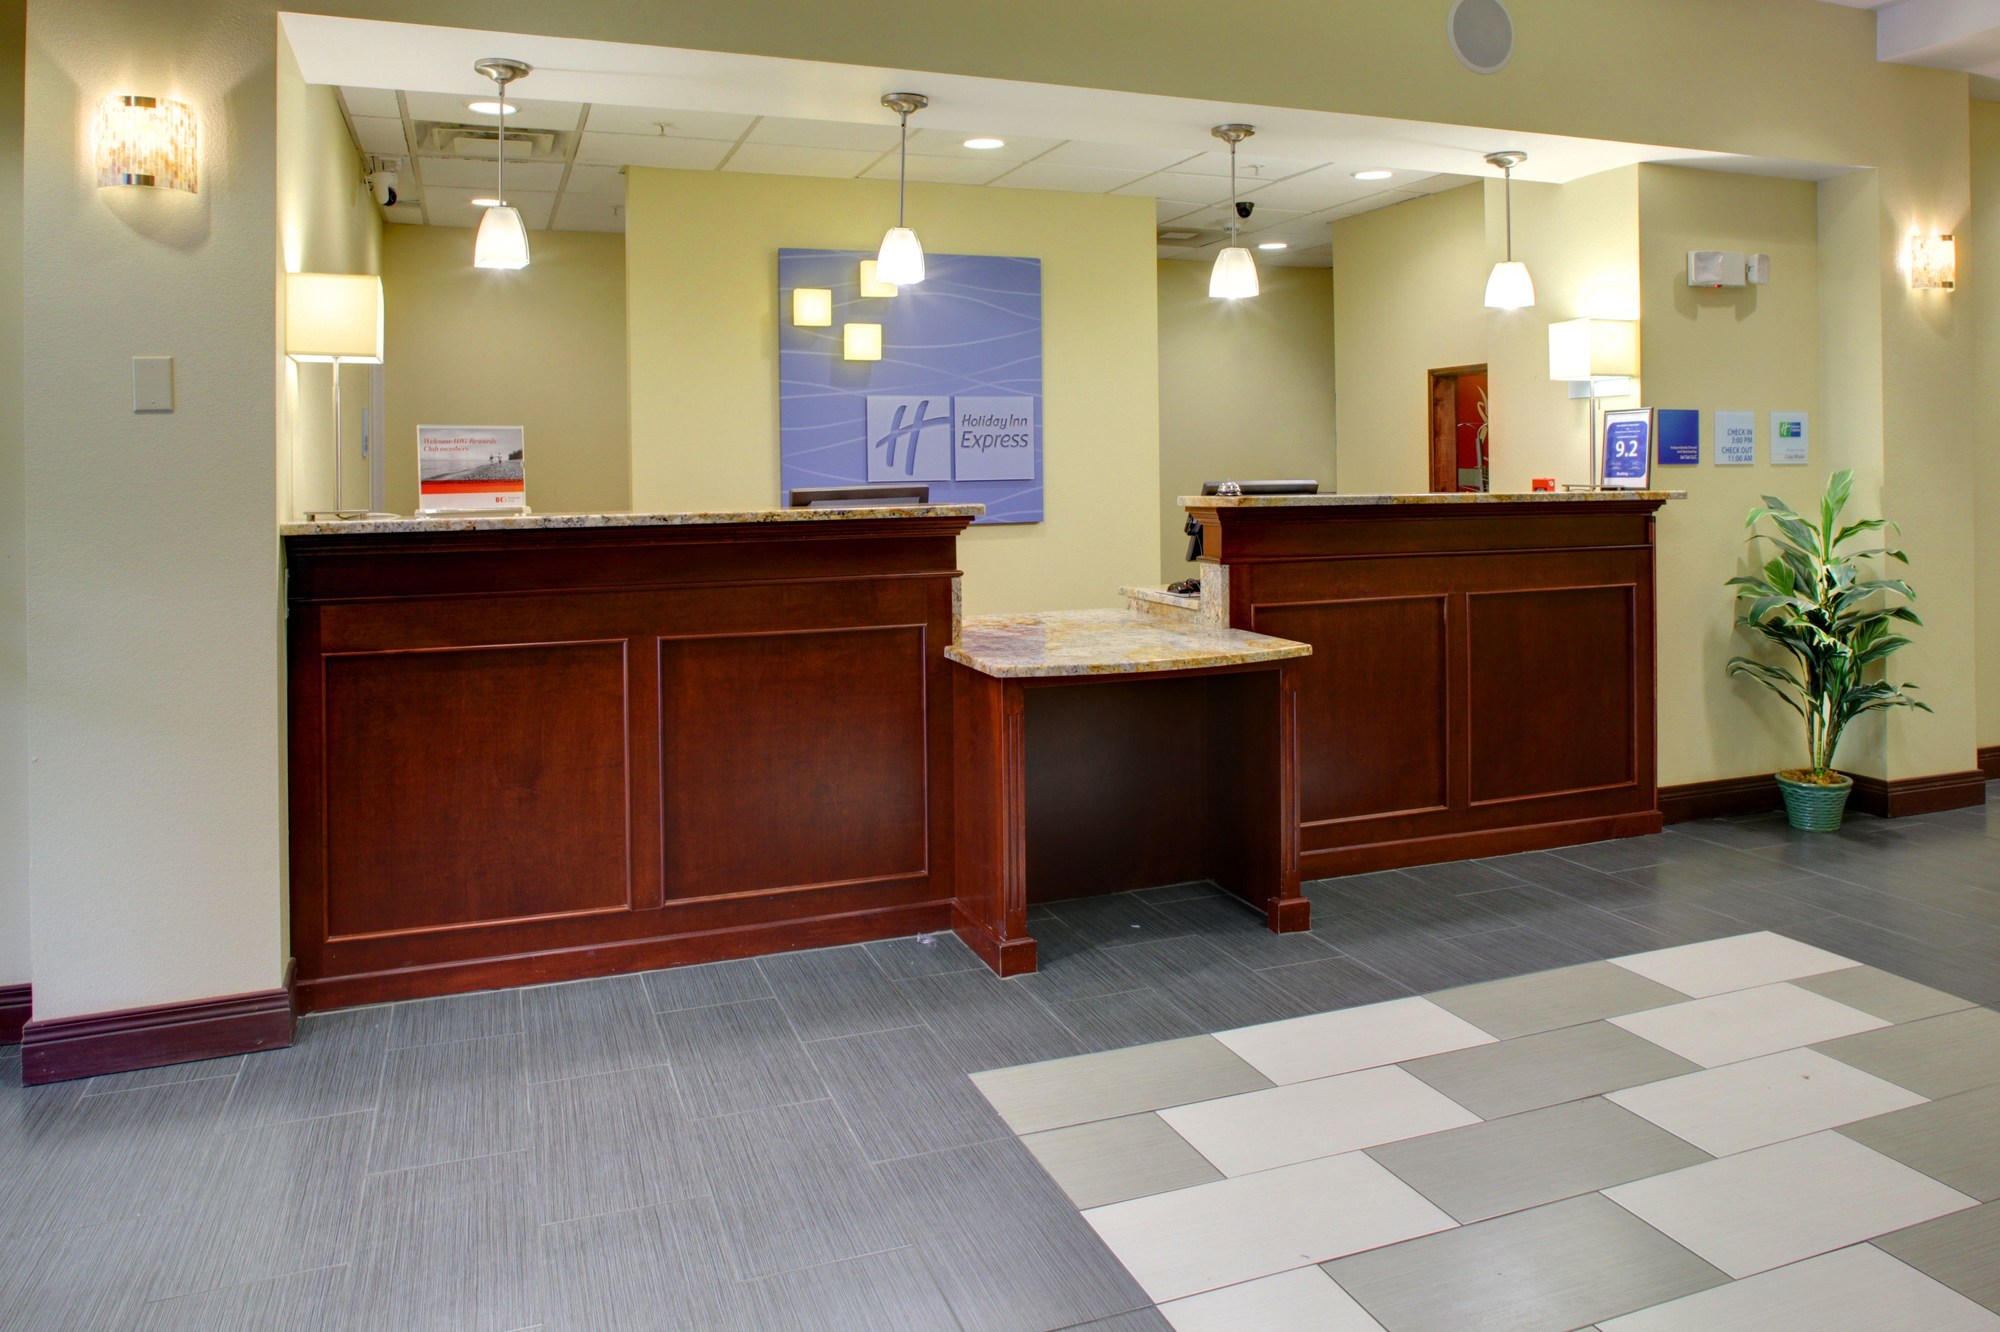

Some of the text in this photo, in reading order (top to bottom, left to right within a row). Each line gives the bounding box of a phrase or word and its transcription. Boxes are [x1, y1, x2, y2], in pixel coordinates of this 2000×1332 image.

[961, 414, 1028, 429] Holiday Inn
[1727, 428, 1753, 436] CHECK IN
[960, 430, 1029, 453] Express
[1731, 436, 1753, 444] 3:00 PM
[1615, 440, 1638, 457] 9.2
[1721, 446, 1753, 454] CHECK OUT
